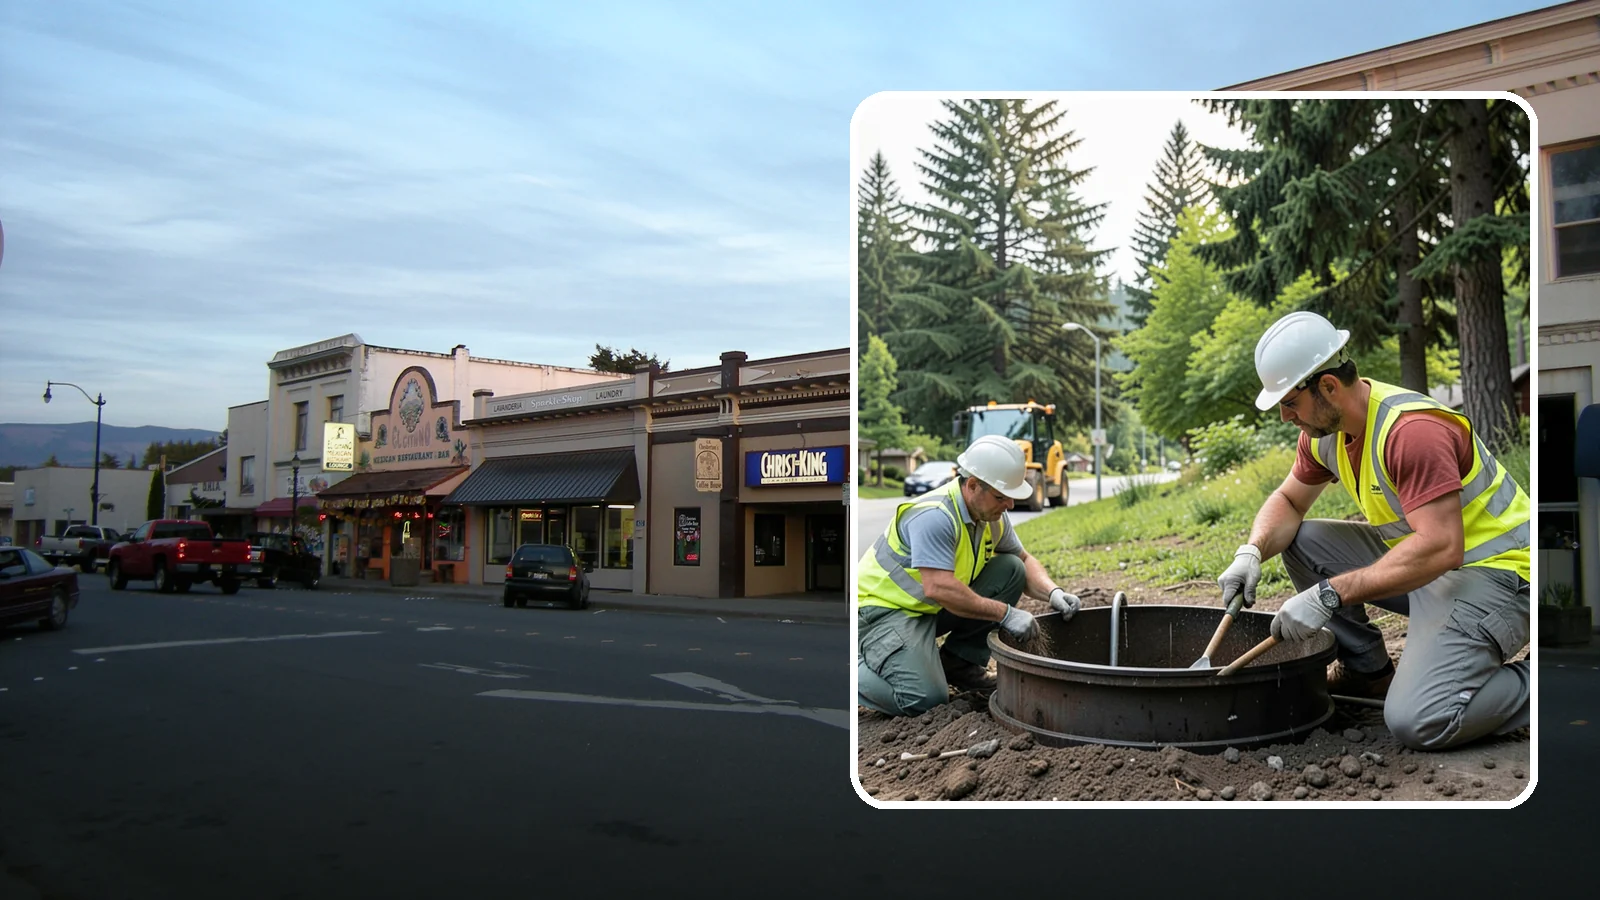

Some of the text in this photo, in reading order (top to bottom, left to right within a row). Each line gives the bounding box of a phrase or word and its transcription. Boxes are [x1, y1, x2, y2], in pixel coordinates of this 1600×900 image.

[531, 394, 582, 409] Sparkle Shop
[595, 389, 623, 400] LAUNDRY
[493, 402, 522, 412] LAVANDERIA
[392, 425, 401, 449] EL
[373, 455, 396, 464] MEXICAN
[397, 451, 433, 462] RESTAURANT
[437, 450, 450, 459] BAR
[761, 452, 797, 478] CHRIST
[799, 450, 827, 476] KING
